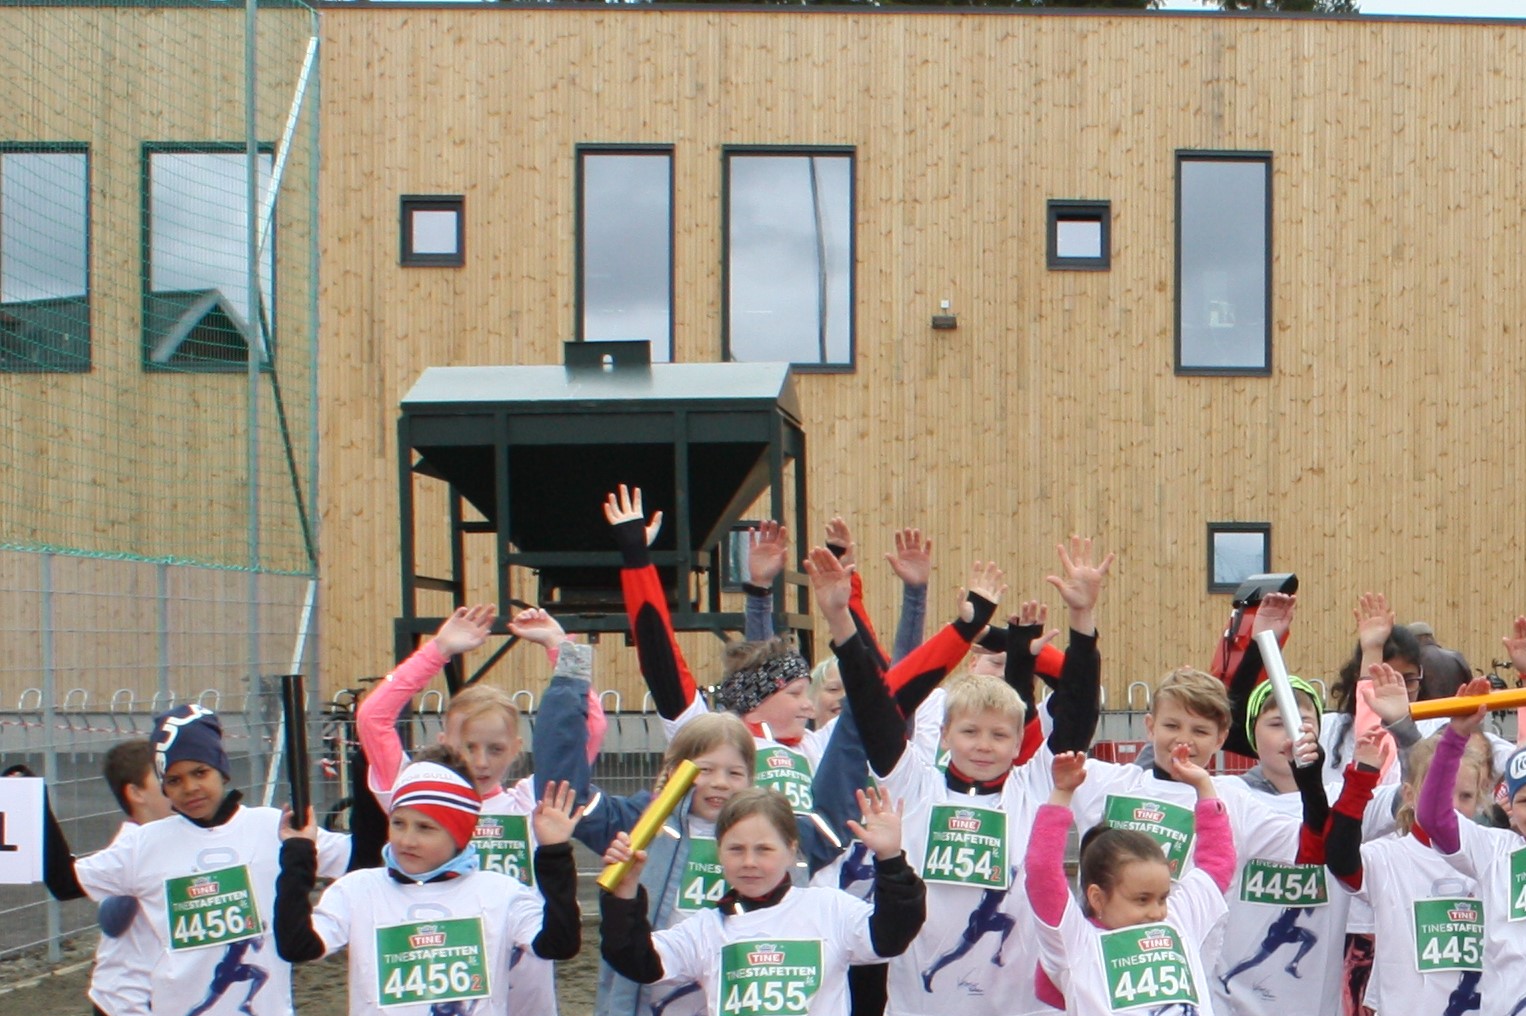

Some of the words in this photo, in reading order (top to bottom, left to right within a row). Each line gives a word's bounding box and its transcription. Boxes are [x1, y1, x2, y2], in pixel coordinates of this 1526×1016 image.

[951, 818, 979, 830] TINE
[1137, 810, 1160, 821] TINE
[932, 831, 1001, 848] TINESTAFETTEN
[1109, 820, 1188, 843] TINESTAFETTEN
[926, 845, 993, 880] 4454
[190, 882, 218, 896] TINE
[1245, 870, 1318, 901] 4454
[172, 889, 248, 913] TINESTAFETTEN
[173, 905, 244, 944] 4456
[1451, 911, 1475, 920] TINE
[412, 932, 443, 947] TINE
[1143, 937, 1170, 949] TINE
[383, 945, 479, 965] TINESTAFETTEN
[752, 953, 781, 963] TINE
[383, 960, 471, 998] 4456
[726, 964, 817, 983] TINESTAFETTEN
[723, 980, 808, 1016] 4455
